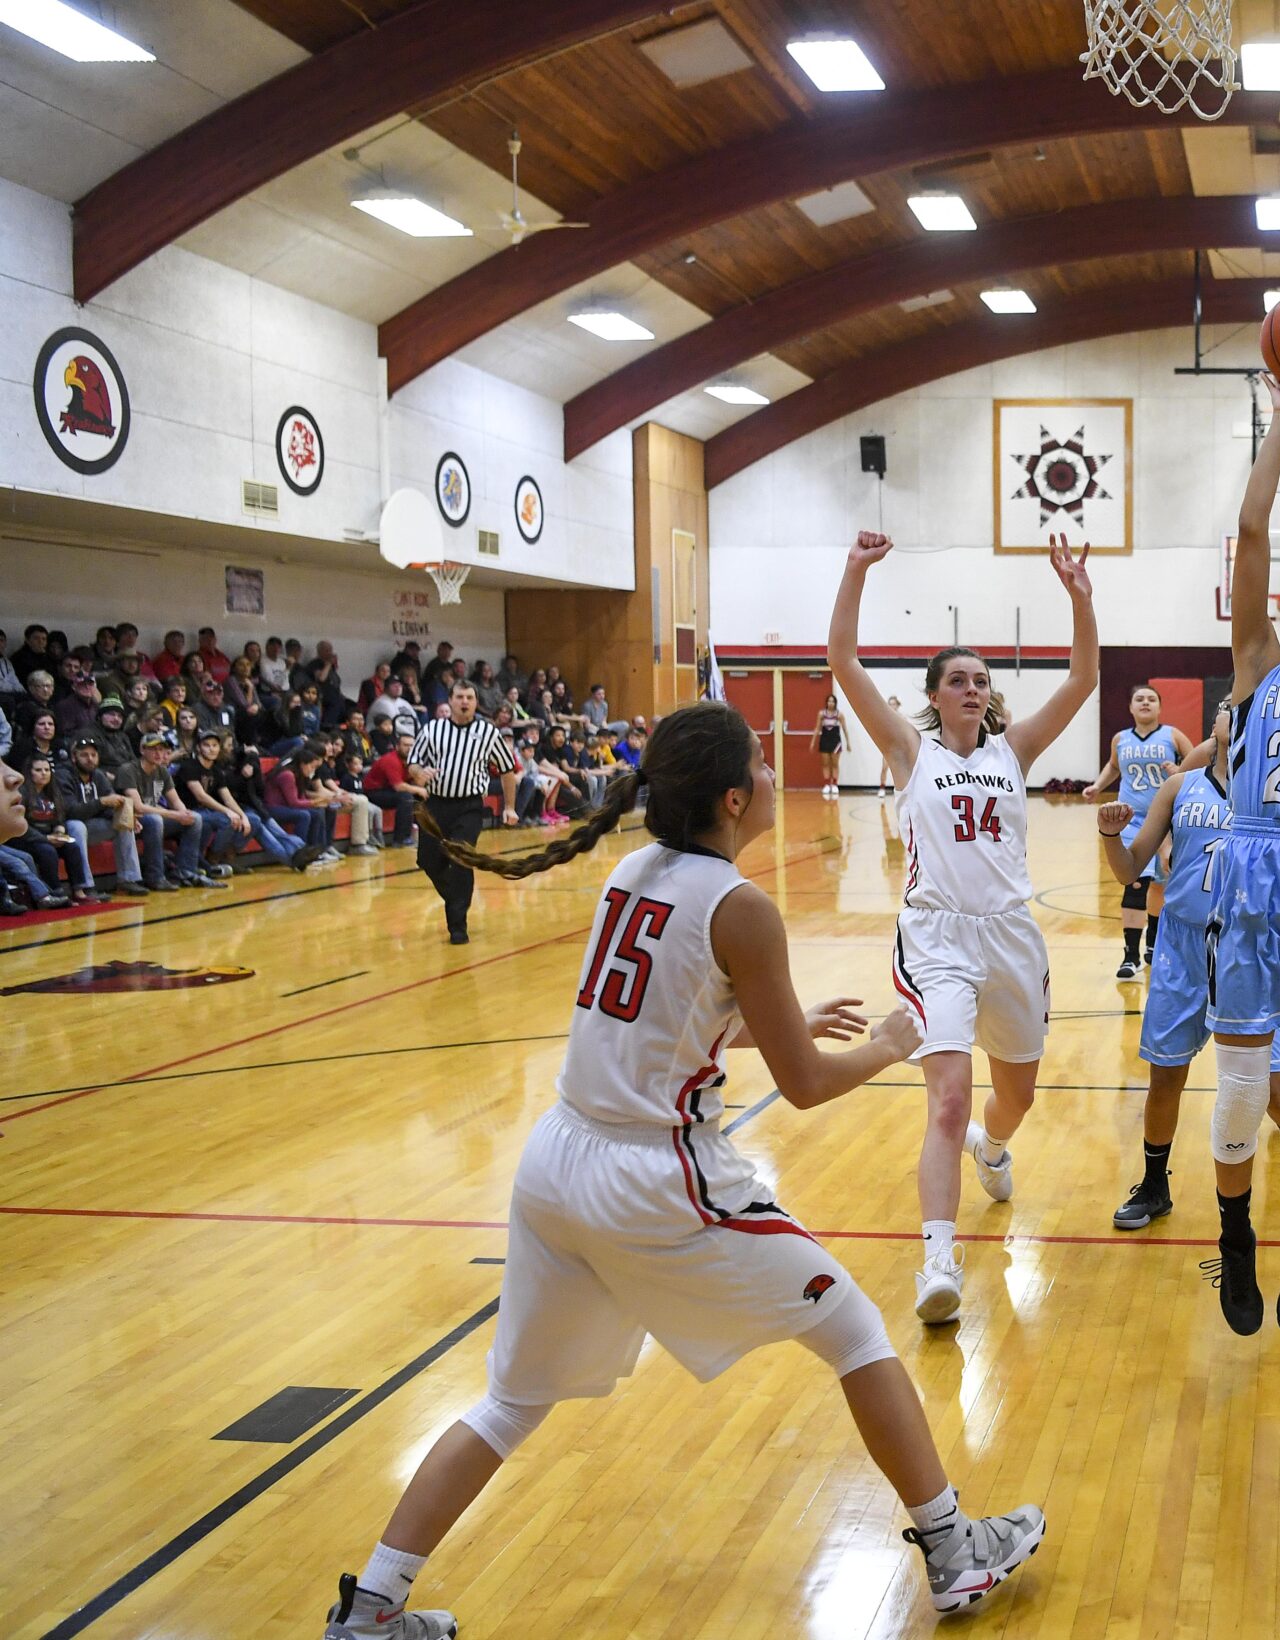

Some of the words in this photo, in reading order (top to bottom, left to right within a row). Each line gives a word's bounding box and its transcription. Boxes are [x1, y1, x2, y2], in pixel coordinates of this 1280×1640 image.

[1121, 744, 1166, 760] FRAZER
[934, 770, 1014, 793] REDHAWKS
[1127, 762, 1165, 792] 20
[951, 794, 1001, 842] 34
[1177, 802, 1235, 832] FRAZ
[576, 887, 675, 1023] 15
